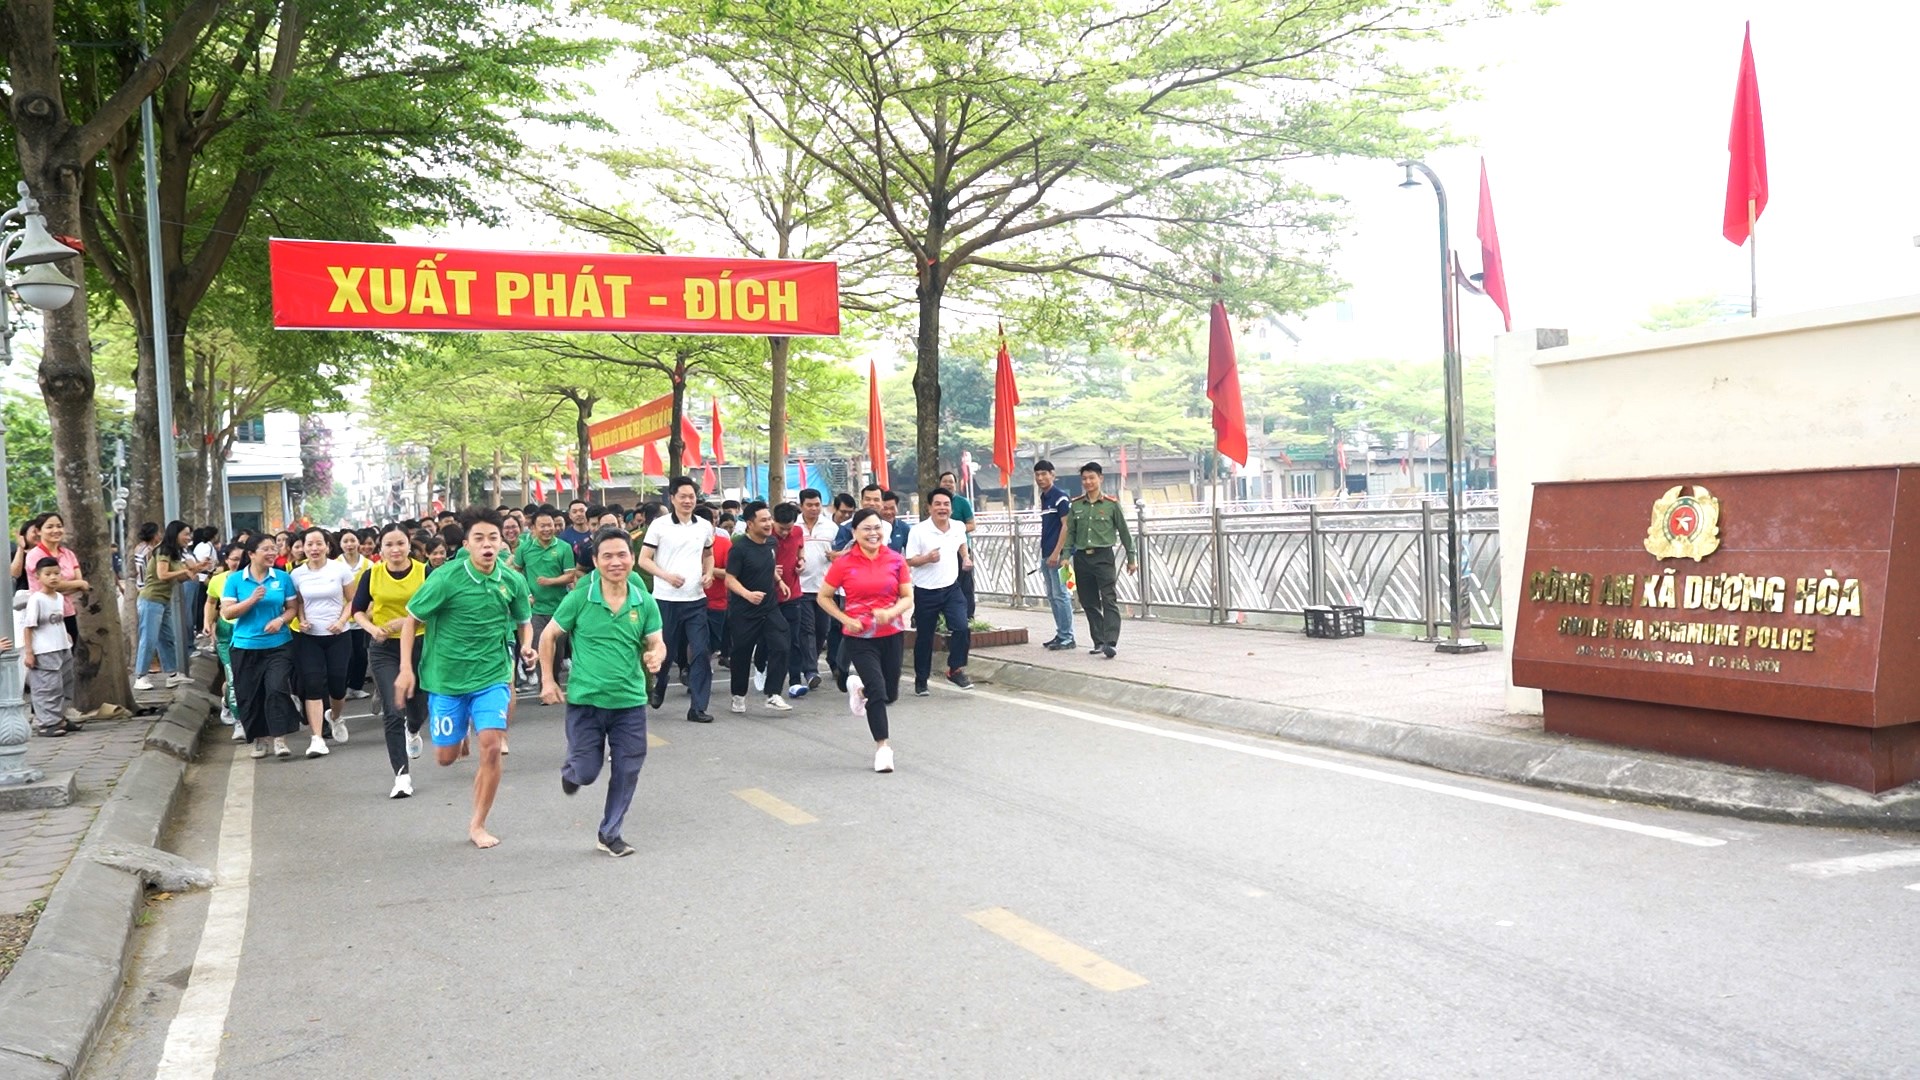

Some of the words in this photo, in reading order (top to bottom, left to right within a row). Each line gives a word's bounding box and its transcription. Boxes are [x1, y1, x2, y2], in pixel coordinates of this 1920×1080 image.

[327, 252, 477, 315] XUẤT
[496, 264, 632, 318] PHÁT
[649, 296, 667, 306] -
[683, 269, 799, 323] ĐÍCH
[1529, 566, 1593, 604] CÔNG
[1598, 573, 1635, 606] AN
[1640, 567, 1677, 609] XÃ
[1683, 572, 1787, 613] DƯƠNG
[1794, 568, 1862, 617] HÒA
[1613, 618, 1645, 641] HOA
[1649, 620, 1740, 647] COMMUNE
[1744, 625, 1815, 652] POLICE
[433, 715, 454, 736] 30
